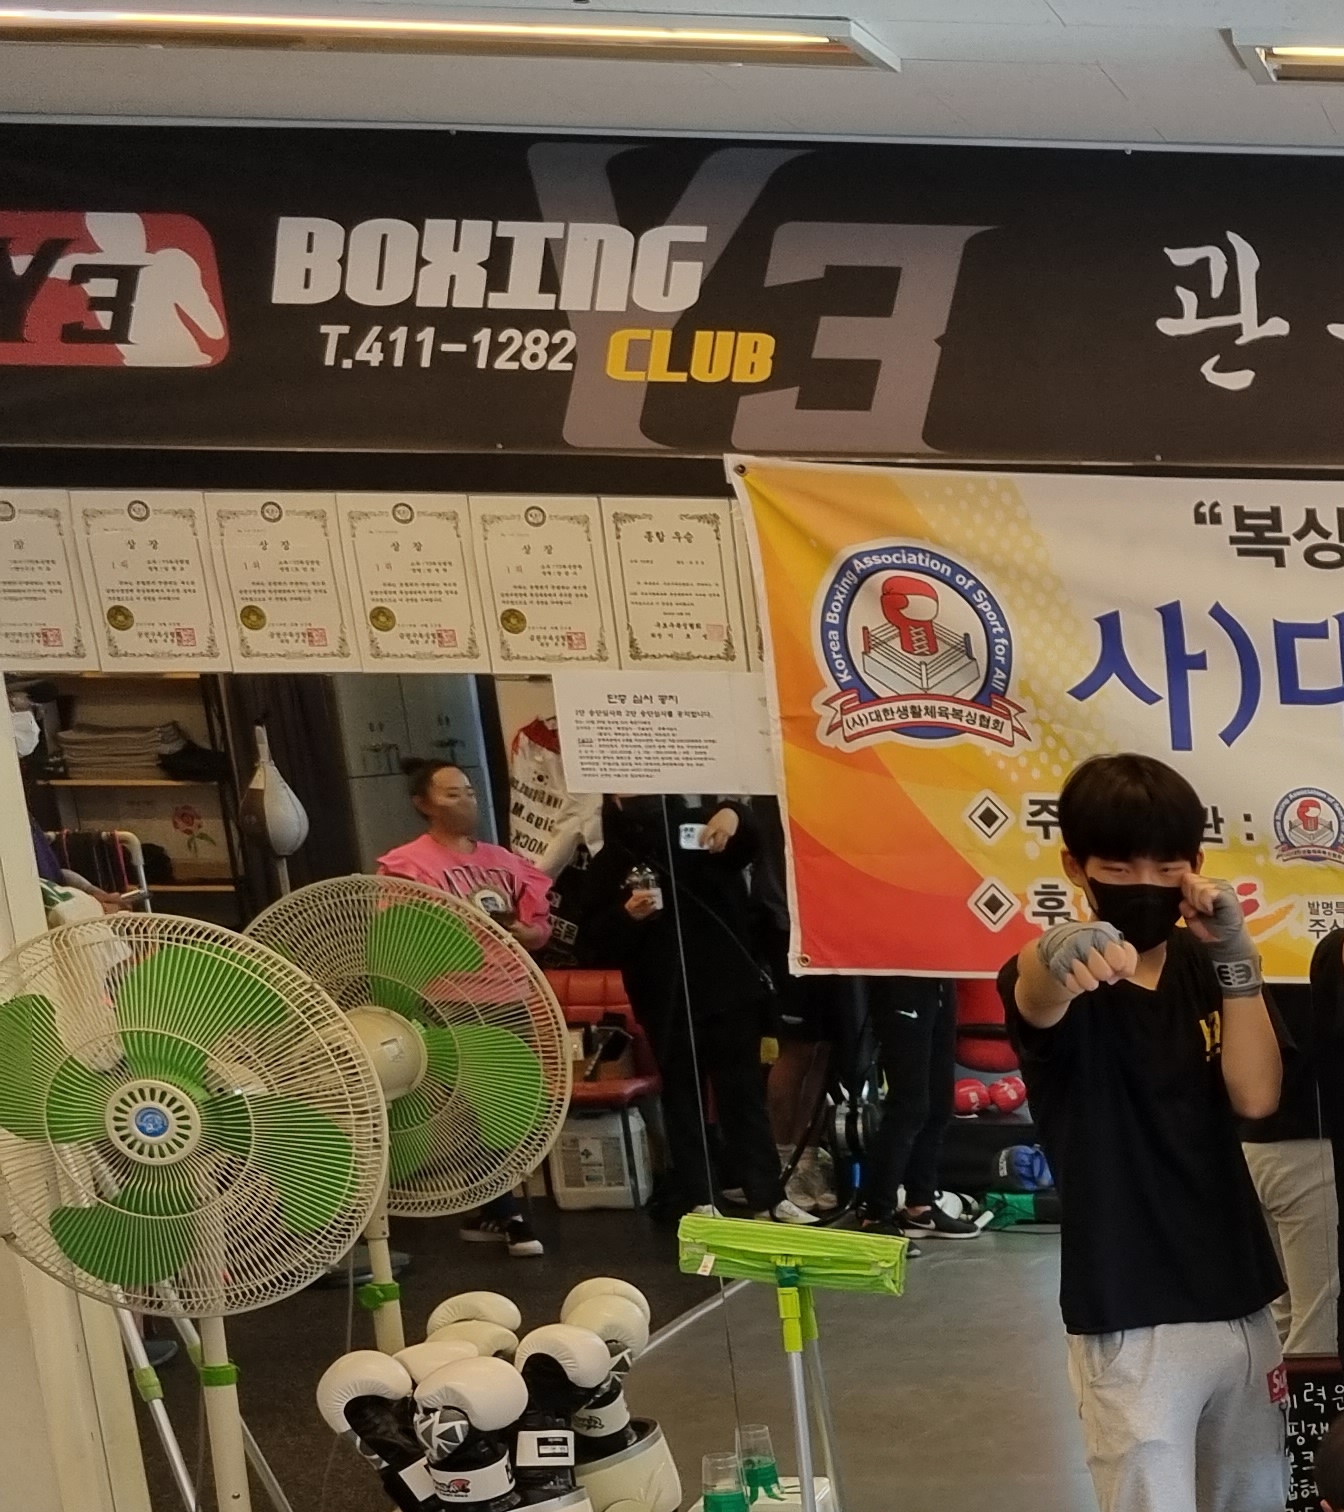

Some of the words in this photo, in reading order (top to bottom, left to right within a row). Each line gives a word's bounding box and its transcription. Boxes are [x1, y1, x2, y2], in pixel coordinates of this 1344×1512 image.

[270, 216, 709, 313] BOXING
[319, 325, 577, 372] T.411-1282
[606, 328, 776, 383] CLUB
[853, 549, 951, 577] Association
[955, 573, 976, 591] of
[825, 569, 858, 625] Boxing
[972, 590, 1006, 635] Sport
[831, 630, 852, 683] Korea
[994, 637, 1010, 664] for
[991, 668, 1009, 692] All
[845, 704, 1005, 734] (사)대한생활체육복싱협회
